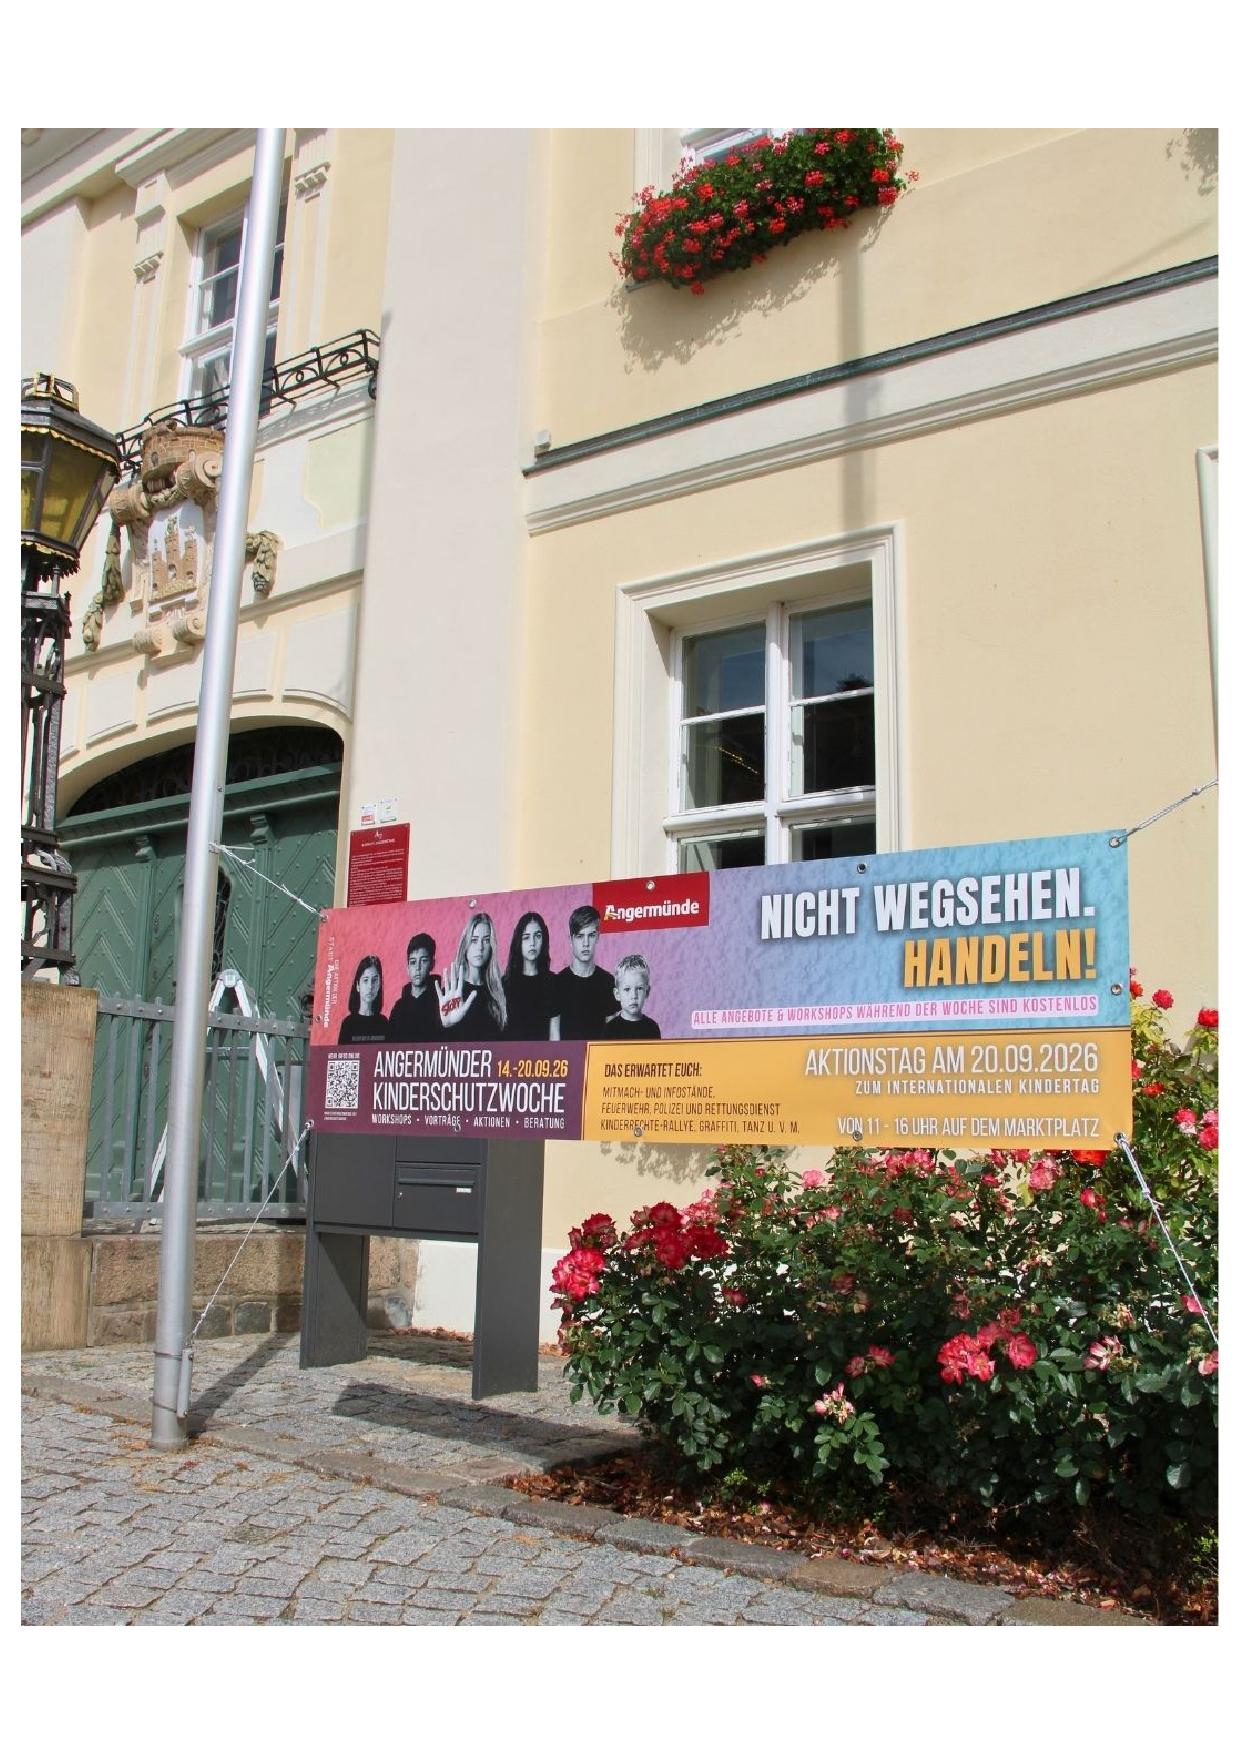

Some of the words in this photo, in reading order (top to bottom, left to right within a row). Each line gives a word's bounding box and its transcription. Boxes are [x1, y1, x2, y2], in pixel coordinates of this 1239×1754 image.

[603, 899, 700, 922] Angermünde
[761, 887, 860, 940] NICHT
[874, 867, 1096, 932] WEGSEHEN.
[904, 928, 1097, 988] HANDELN!
[323, 964, 335, 1028] Angermünde
[693, 1011, 717, 1025] ALLE
[721, 1009, 773, 1023] ANGEBOTE
[787, 1006, 853, 1021] WORKSHOPS
[856, 1002, 910, 1019] WÄHREND
[915, 1001, 937, 1017] DER
[942, 999, 983, 1016] WOCHE
[988, 998, 1018, 1014] SIND
[1023, 995, 1097, 1012] KOSTENLOS
[374, 1046, 492, 1078] ANGERMÜNDER
[497, 1059, 568, 1078] 14.-20.09.26
[604, 1064, 623, 1078] DAS
[624, 1063, 673, 1078] ERWARTET
[675, 1061, 703, 1077] EUCH:
[805, 1046, 926, 1076] AKTIONSTAG
[932, 1046, 964, 1074] AM
[970, 1043, 1098, 1073] 20.09.2026
[373, 1081, 566, 1113] KINDERSCHUTZWOCHE
[602, 1086, 643, 1099] MITMACH-
[645, 1086, 662, 1098] UND
[855, 1080, 881, 1094] ZUM
[887, 1079, 1012, 1094] INTERNATIONALEN
[1019, 1078, 1099, 1094] KINDERTAG
[601, 1102, 652, 1115] FEUERWEHR,
[654, 1102, 684, 1115] POLIZEI
[685, 1102, 703, 1115] UND
[705, 1102, 781, 1116] RETTUNGSDIENST
[371, 1113, 412, 1125] WORKSHOPS
[425, 1114, 461, 1127] VORTRÄGE
[473, 1116, 510, 1128] AKTIONEN
[523, 1117, 565, 1129] BERATUNG
[699, 1120, 739, 1134] GRAFFITI,
[743, 1120, 765, 1133] TANZ
[837, 1116, 863, 1135] VON
[867, 1116, 880, 1134] 11
[894, 1117, 909, 1135] 16
[912, 1117, 938, 1135] UHR
[942, 1117, 967, 1135] AUF
[971, 1117, 1000, 1137] DEM
[1004, 1117, 1099, 1138] MARKTPLATZ
